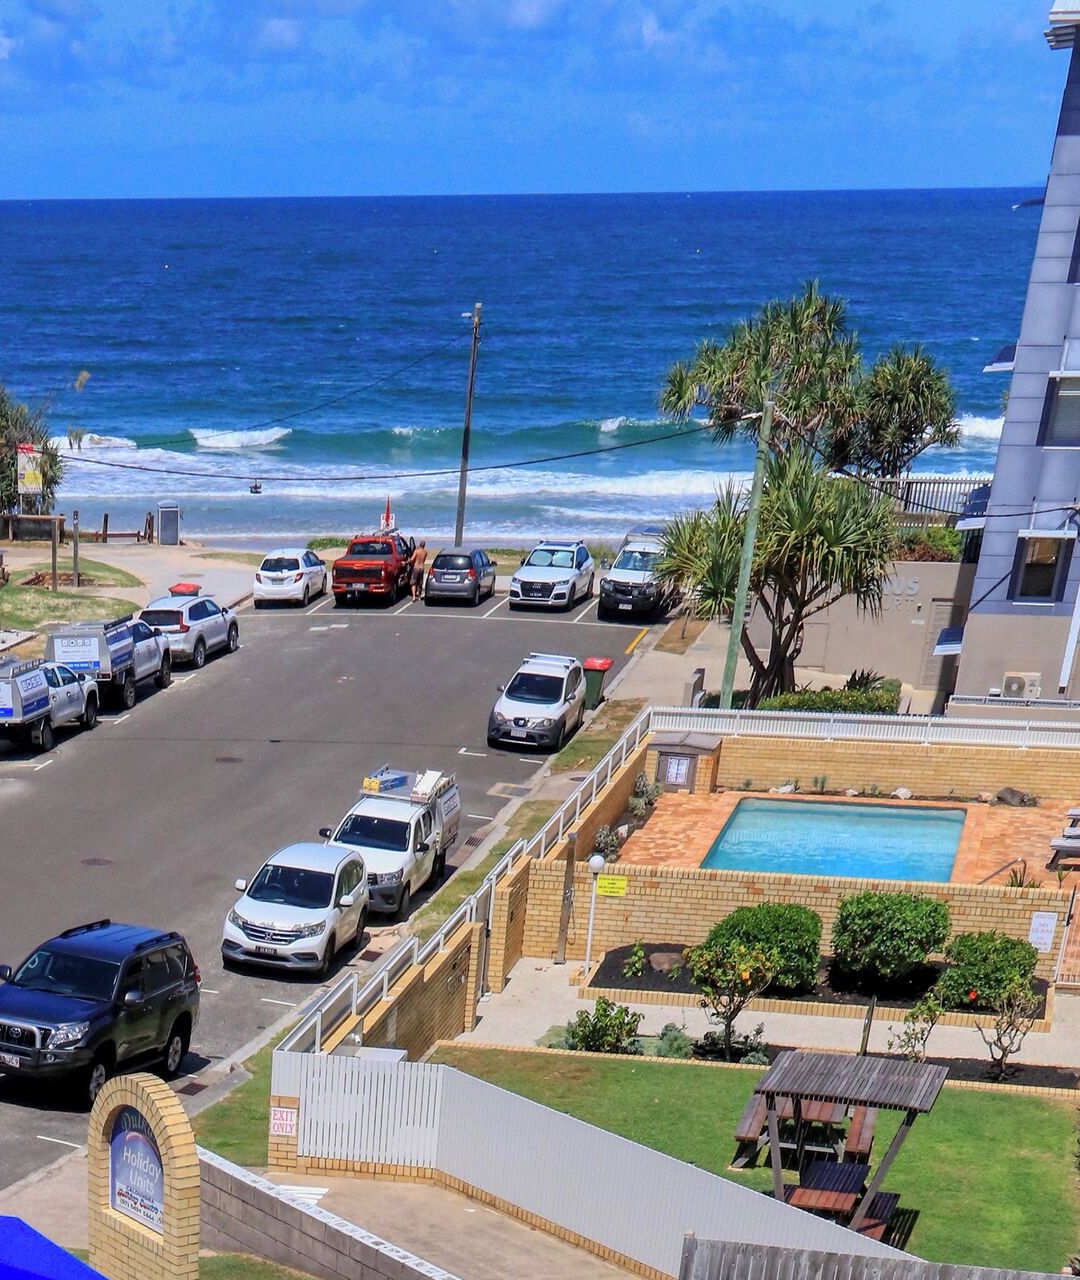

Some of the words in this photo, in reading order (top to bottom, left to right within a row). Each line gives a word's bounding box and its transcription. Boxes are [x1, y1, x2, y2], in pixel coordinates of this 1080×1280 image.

[273, 1109, 296, 1121] EXIT
[272, 1122, 295, 1133] ONLY
[123, 1146, 161, 1184] Holiday
[129, 1167, 155, 1195] Units
